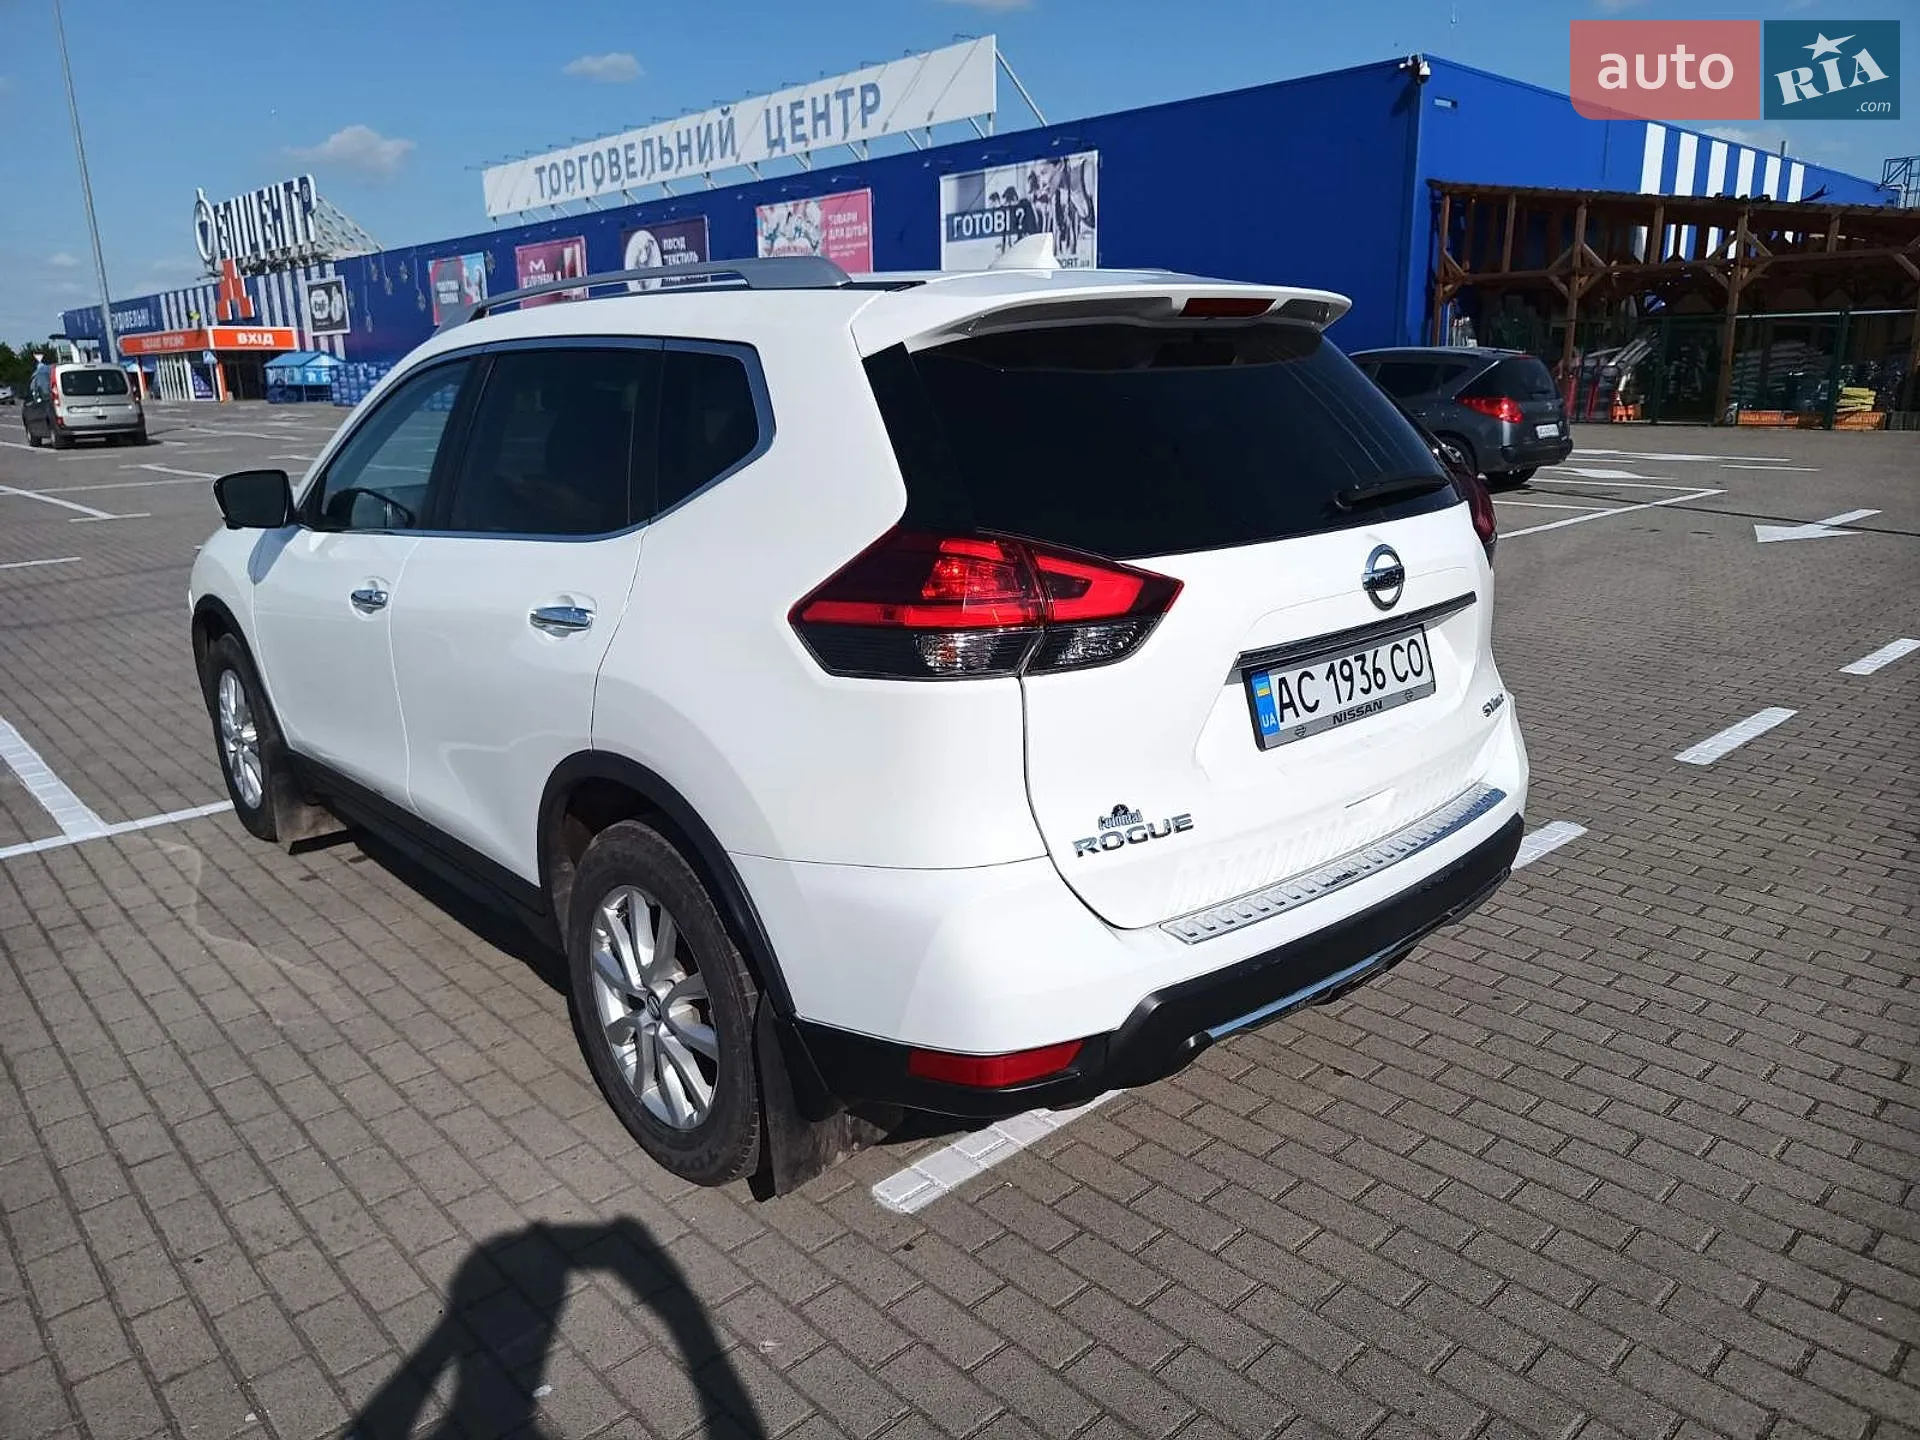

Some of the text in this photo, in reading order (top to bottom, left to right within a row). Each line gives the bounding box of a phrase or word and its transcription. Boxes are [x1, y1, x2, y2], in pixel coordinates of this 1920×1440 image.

[534, 82, 882, 200] ТОРГОВЕЛЬНИЙ ЦЕНТР
[953, 209, 1010, 238] ГОТОВІ
[237, 332, 274, 346] ВХІД
[1278, 638, 1424, 723] AC 1936 CO
[1262, 713, 1278, 728] UA
[1332, 700, 1383, 725] NISSAN
[1073, 813, 1194, 858] ROGUE
